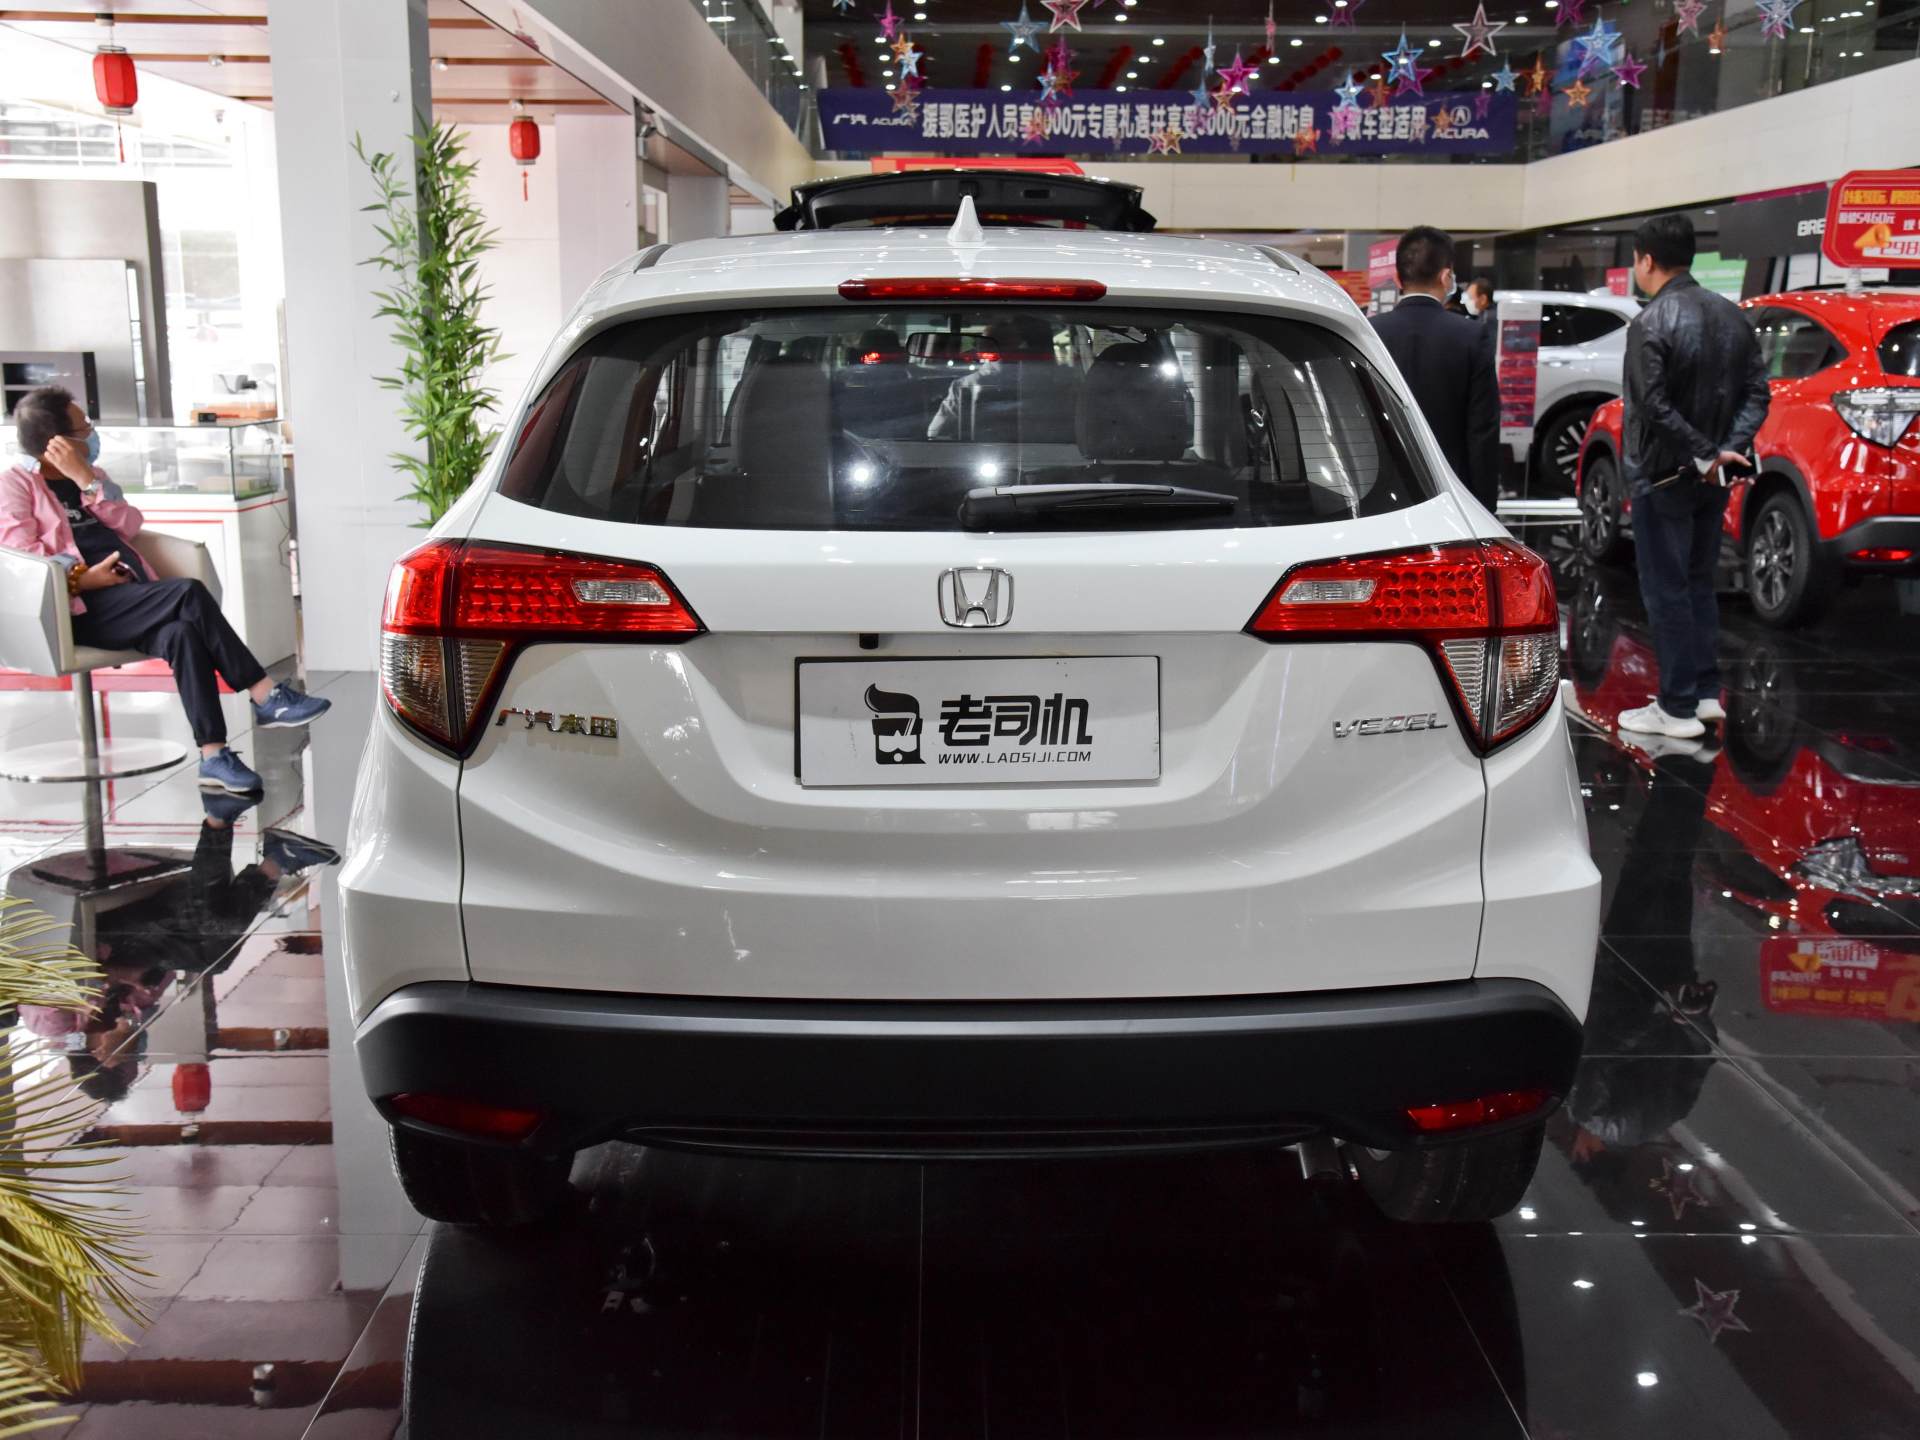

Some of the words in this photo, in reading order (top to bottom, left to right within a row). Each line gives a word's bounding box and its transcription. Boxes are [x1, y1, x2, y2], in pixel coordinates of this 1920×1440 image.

[1431, 127, 1490, 139] ACURA
[496, 707, 618, 738] 广汽本田
[938, 693, 1093, 747] 老司机
[1333, 713, 1448, 738] VEZEL
[938, 751, 1093, 765] WWW.LAOSIJI.COM
